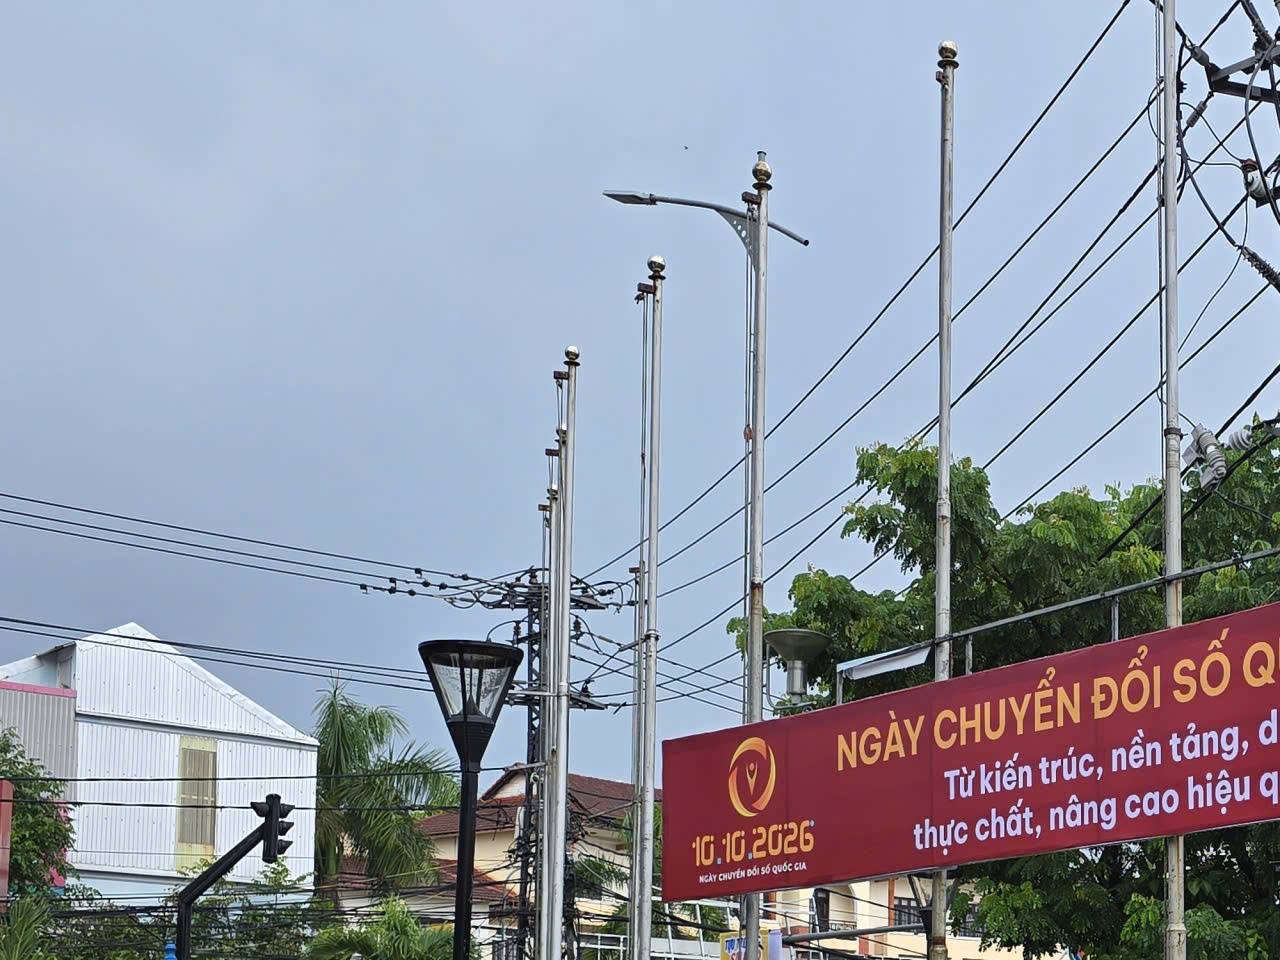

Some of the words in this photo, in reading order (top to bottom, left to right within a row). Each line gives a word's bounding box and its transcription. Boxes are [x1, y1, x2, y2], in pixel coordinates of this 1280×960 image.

[837, 710, 925, 771] NGÀY
[933, 667, 1080, 750] CHUYỂN
[1091, 645, 1161, 720] ĐỔI
[1173, 627, 1231, 703] SỐ
[944, 766, 976, 800] Từ
[980, 752, 1032, 795] kiến
[1039, 747, 1103, 785] trúc,
[1111, 728, 1162, 772] nền
[1170, 722, 1249, 763] tảng,
[692, 819, 815, 867] 10.10.2026
[913, 818, 968, 855] thực
[975, 798, 1042, 841] chất,
[1049, 794, 1117, 830] nâng
[1124, 788, 1179, 818] cao
[1187, 769, 1250, 815] hiệu
[699, 870, 717, 883] NGÀY
[719, 867, 745, 882] CHUYỂN
[747, 864, 760, 877] ĐỔI
[761, 862, 771, 875] SỐ
[772, 862, 793, 874] QUỐC
[794, 861, 807, 871] GIA
